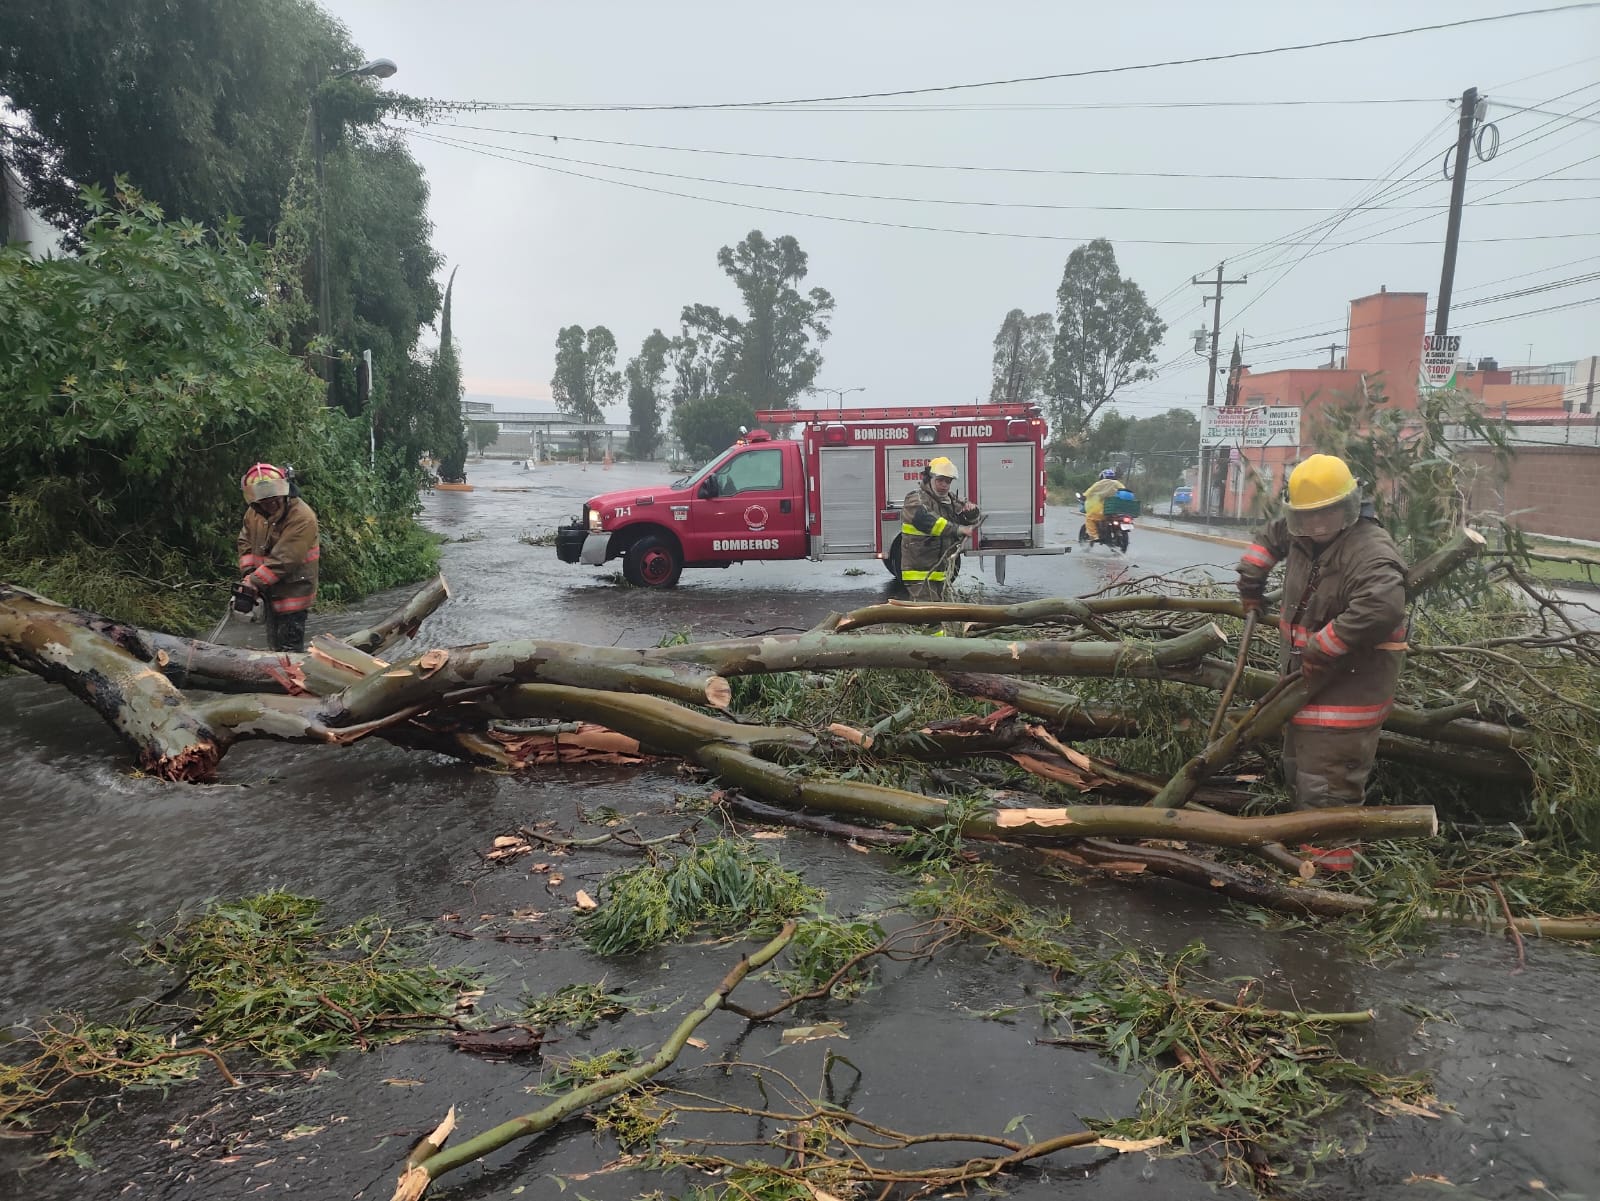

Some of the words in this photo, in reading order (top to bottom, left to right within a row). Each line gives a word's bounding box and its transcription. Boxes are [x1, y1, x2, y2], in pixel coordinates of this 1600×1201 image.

[1427, 365, 1451, 374] $1000
[854, 427, 909, 441] BOMBEROS
[950, 425, 993, 438] ATLIXCO
[903, 459, 930, 467] RESC
[614, 506, 631, 518] 77-1
[712, 539, 779, 551] BOMBEROS
